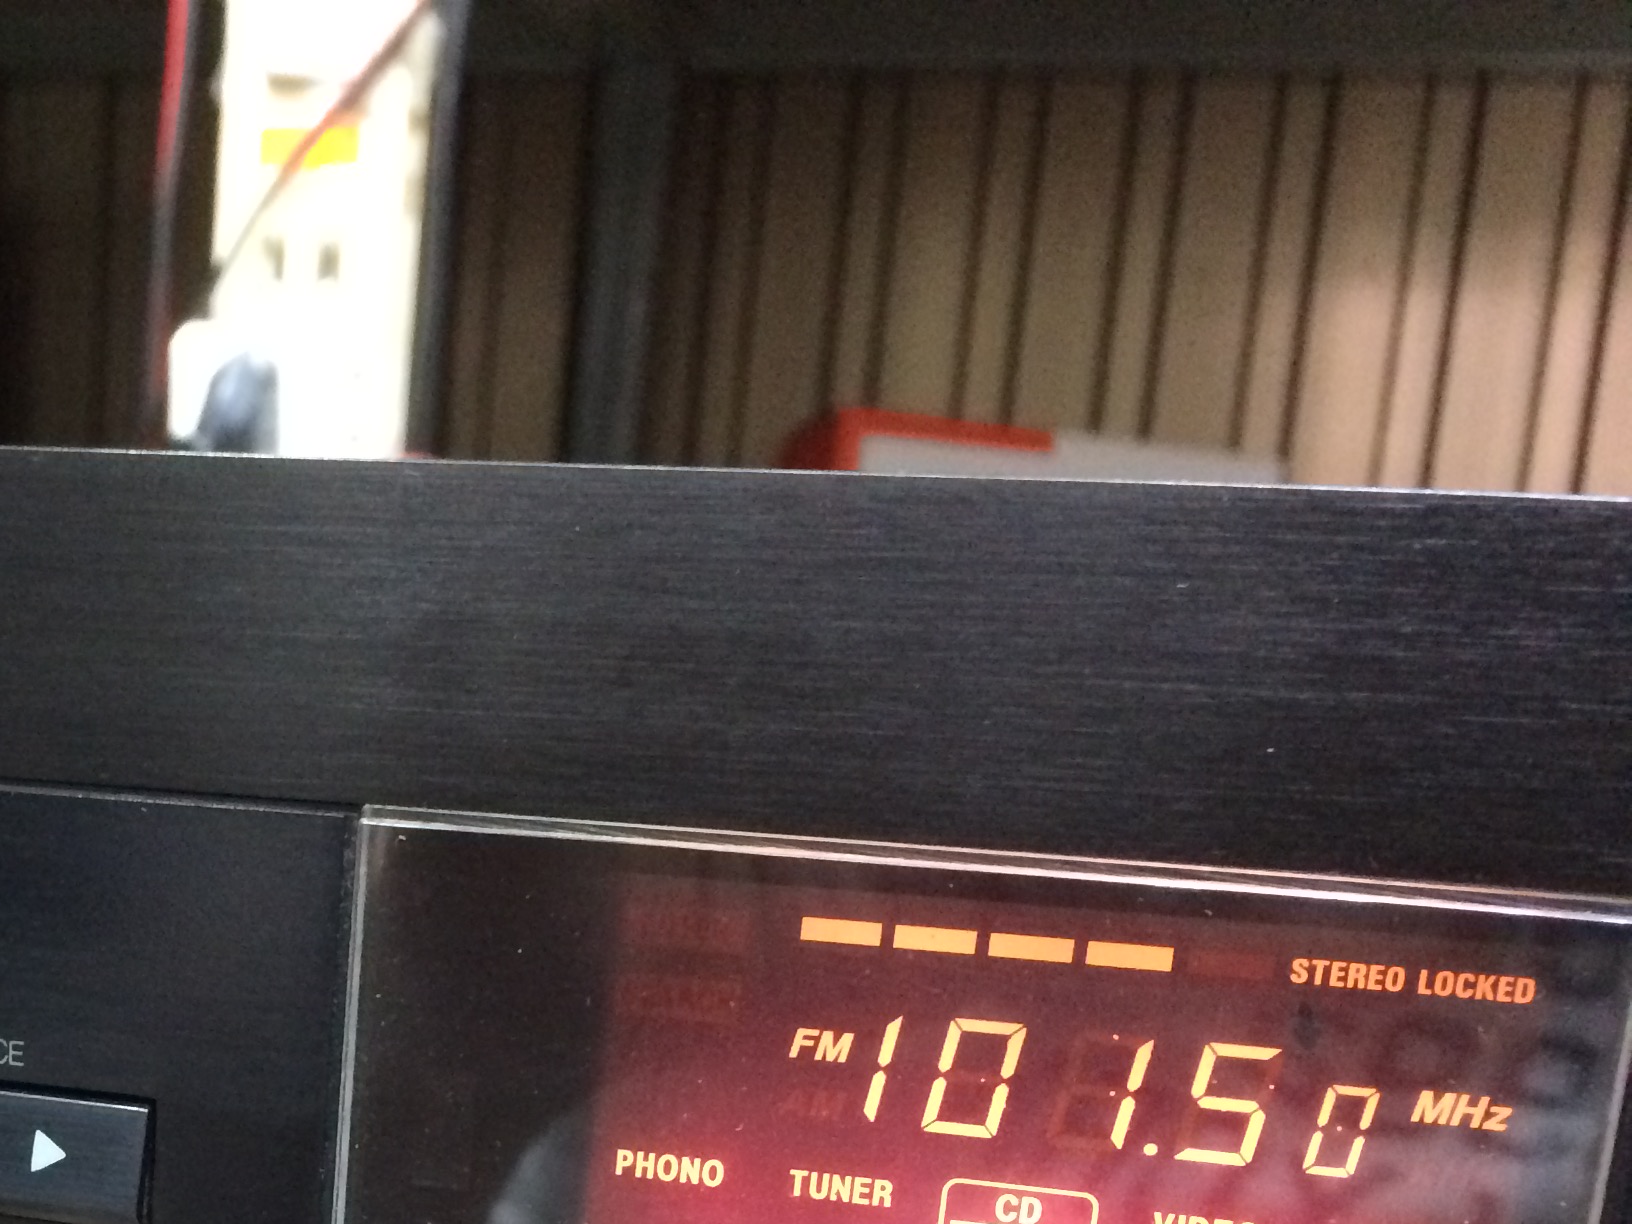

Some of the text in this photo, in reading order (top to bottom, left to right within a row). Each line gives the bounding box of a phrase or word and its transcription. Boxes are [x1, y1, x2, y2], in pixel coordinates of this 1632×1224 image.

[1290, 957, 1536, 1005] STEREO LOCKED
[789, 1027, 855, 1063] FM
[1411, 1090, 1514, 1132] MHz
[614, 1149, 725, 1189] PHONO
[789, 1169, 894, 1209] TUNER
[994, 1193, 1044, 1224] CD
